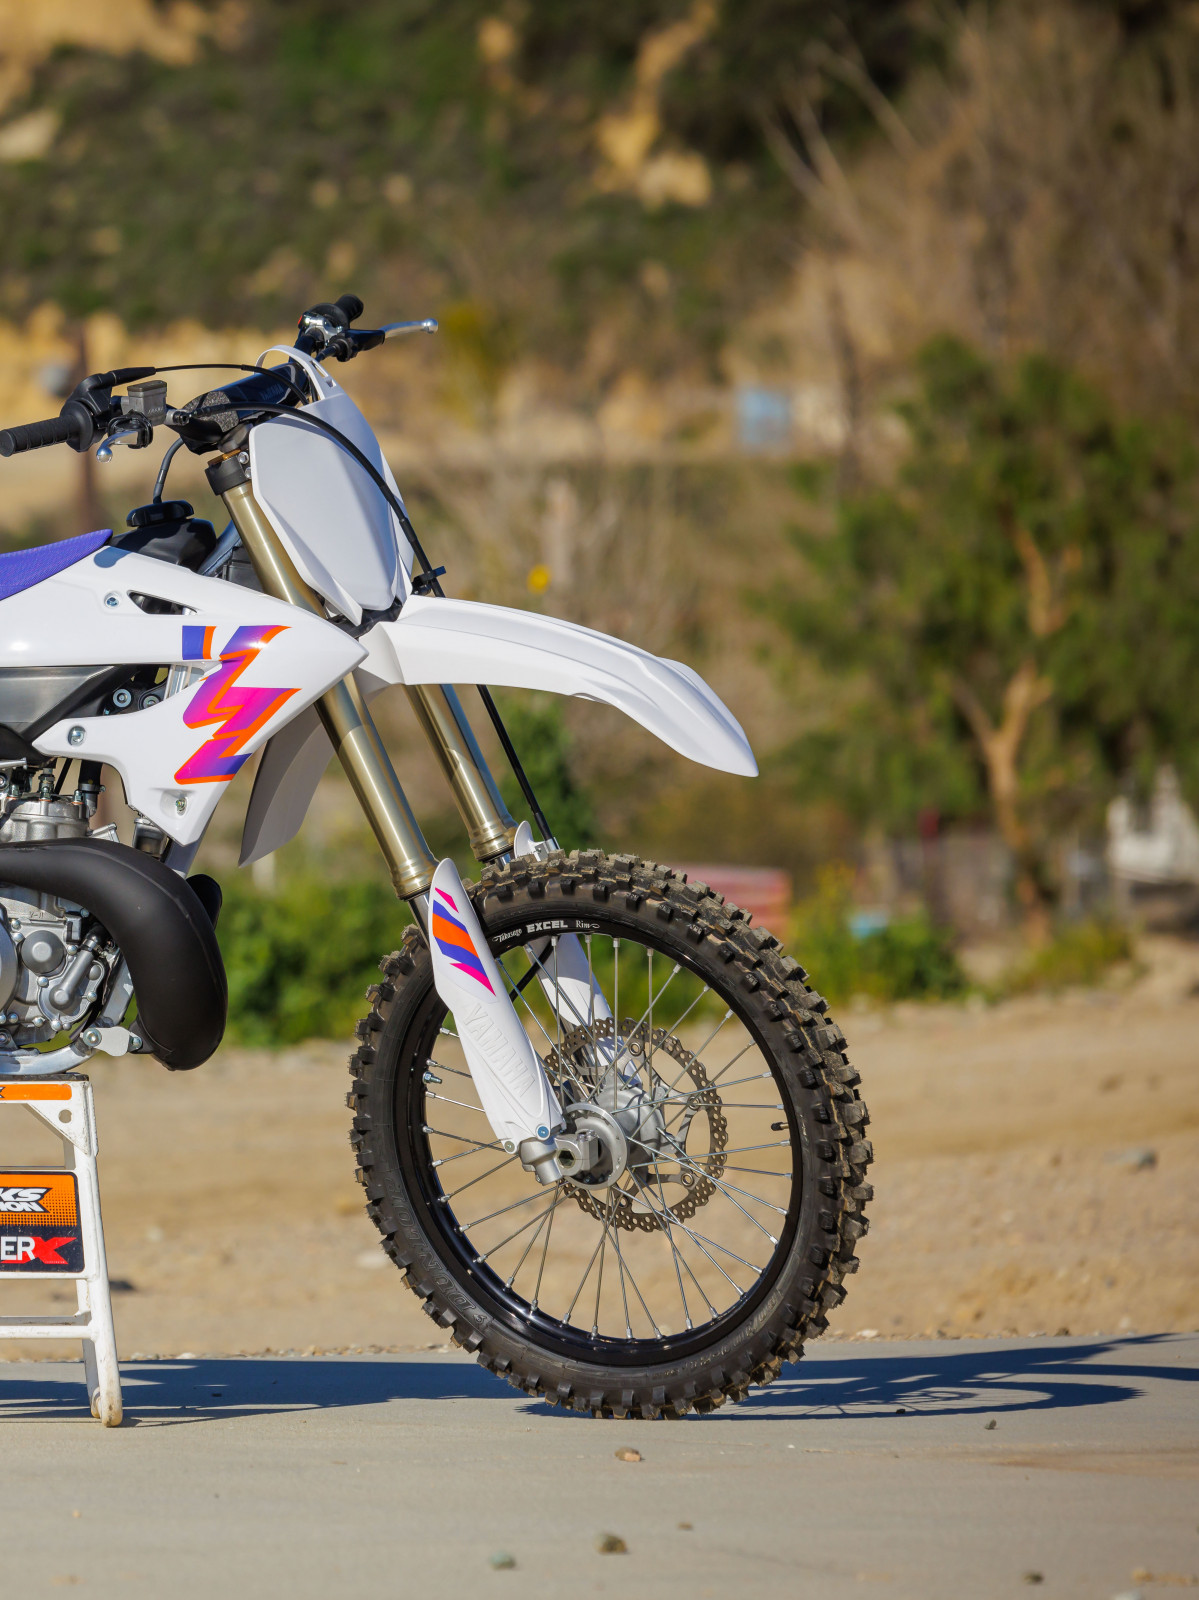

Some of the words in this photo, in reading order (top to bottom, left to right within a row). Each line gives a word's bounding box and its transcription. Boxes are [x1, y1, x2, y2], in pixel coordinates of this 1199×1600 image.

[526, 919, 568, 933] EXCEL
[575, 919, 592, 929] Rim
[463, 1002, 536, 1097] YAMAHA
